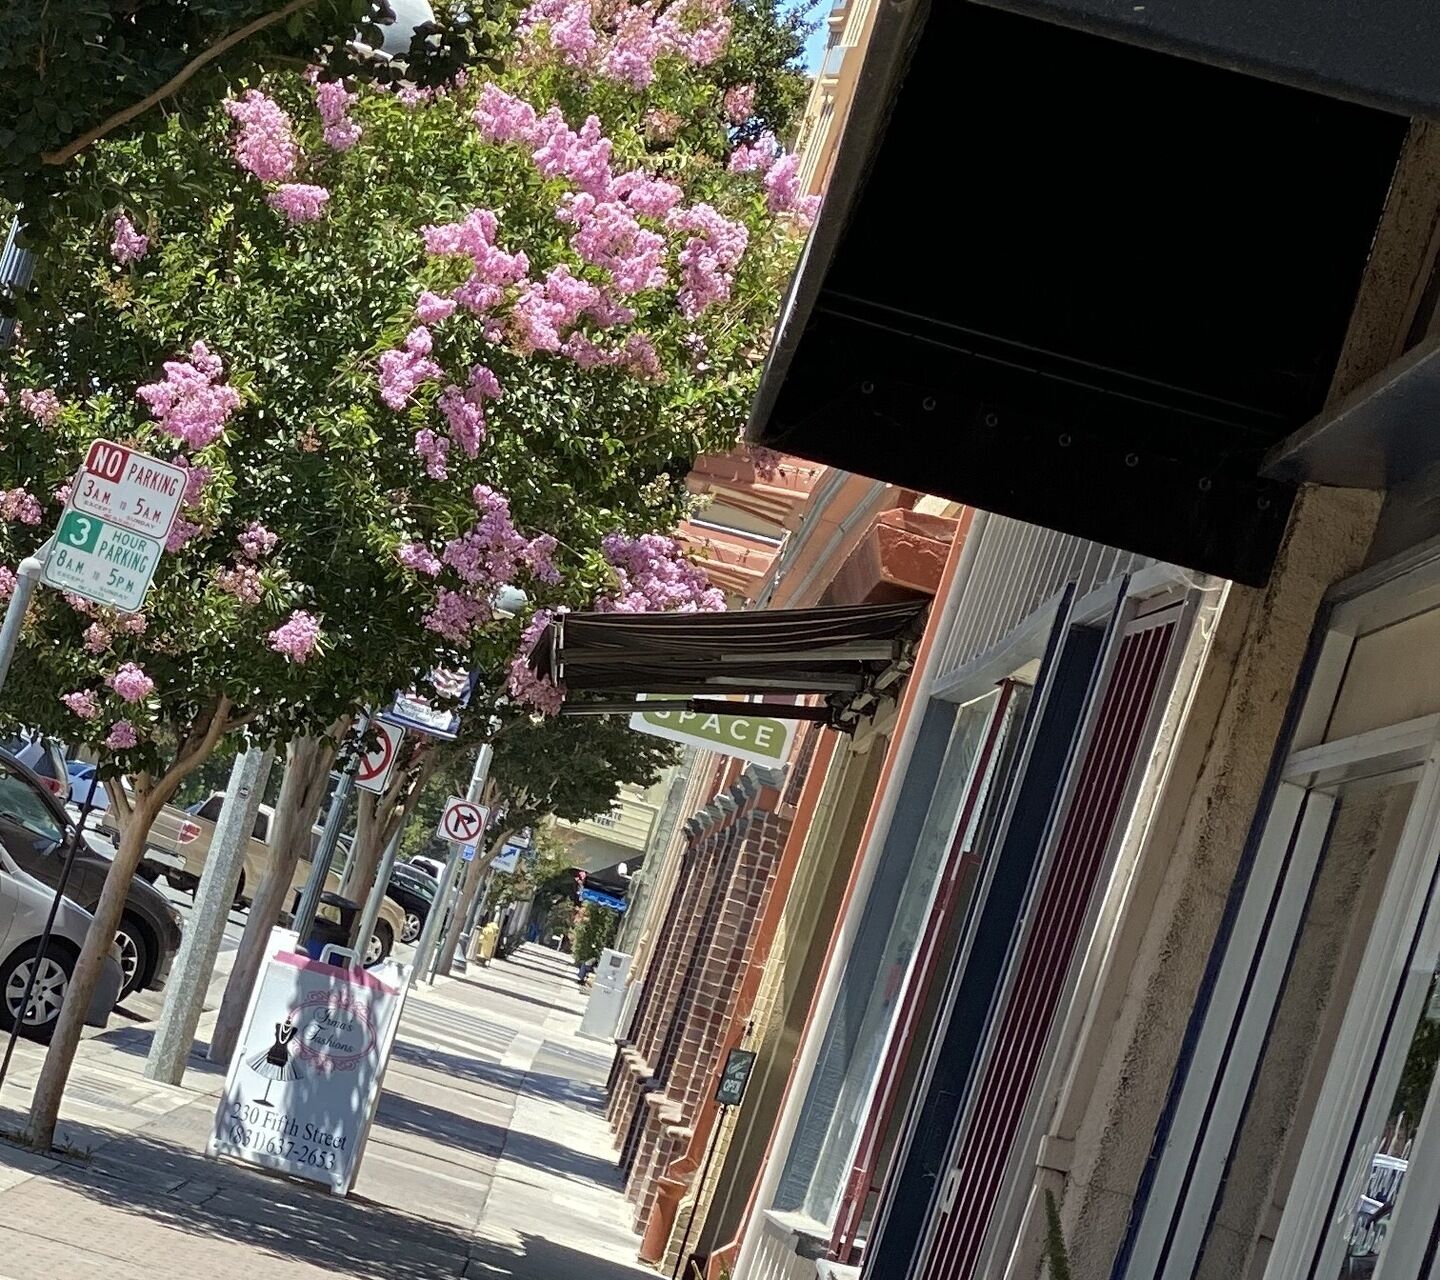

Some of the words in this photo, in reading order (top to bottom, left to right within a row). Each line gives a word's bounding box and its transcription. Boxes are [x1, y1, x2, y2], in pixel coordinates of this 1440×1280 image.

[91, 445, 123, 478] NO
[126, 463, 179, 497] PARKING
[69, 519, 91, 546] 3
[112, 532, 147, 553] HOUR
[98, 541, 149, 574] PARKING
[303, 1024, 353, 1053] Fashions
[230, 1102, 259, 1124] 230
[262, 1111, 298, 1137] Fifth
[303, 1123, 347, 1151] Street
